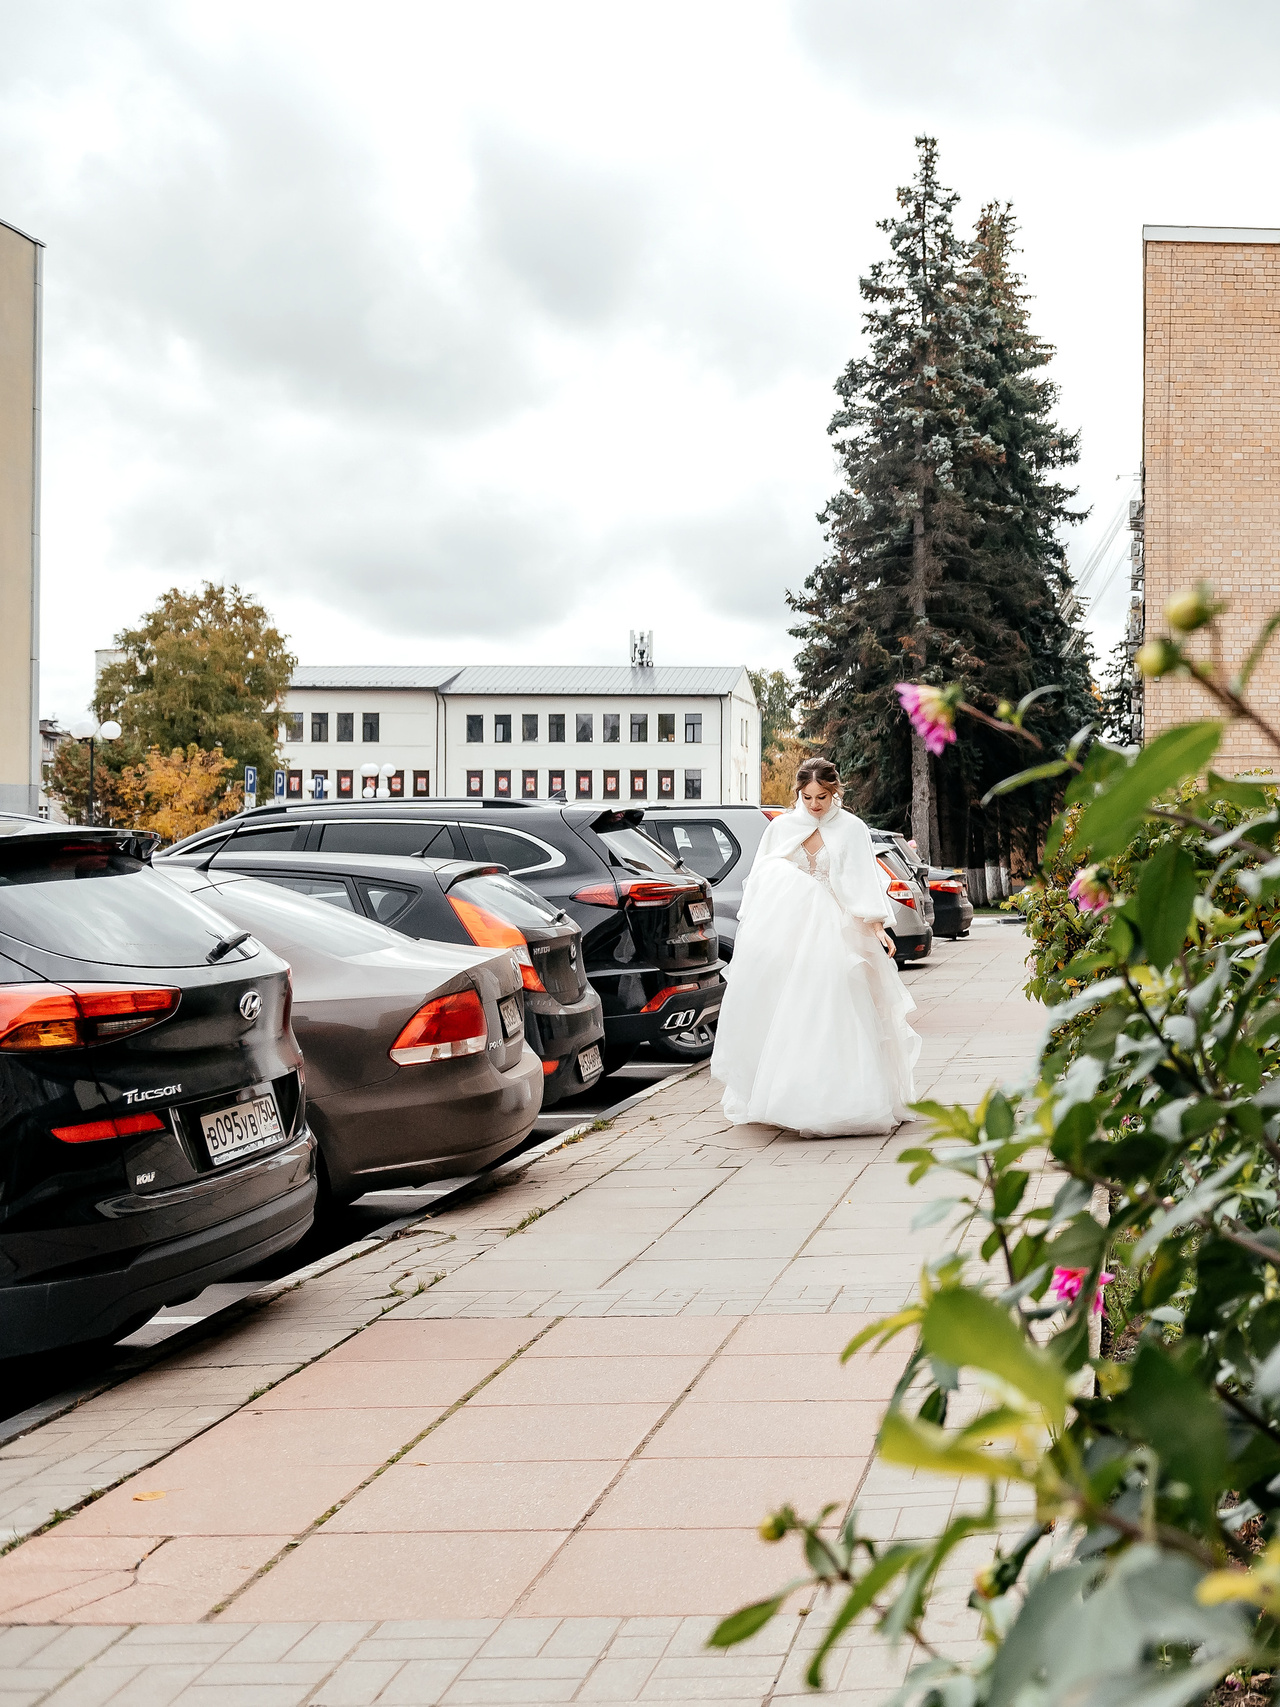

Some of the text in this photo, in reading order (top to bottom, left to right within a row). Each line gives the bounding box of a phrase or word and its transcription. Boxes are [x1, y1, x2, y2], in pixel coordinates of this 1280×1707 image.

[247, 770, 254, 790] P
[277, 774, 283, 793] P
[317, 779, 322, 797] P
[254, 1100, 275, 1124] 750
[136, 1172, 156, 1186] ROLF
